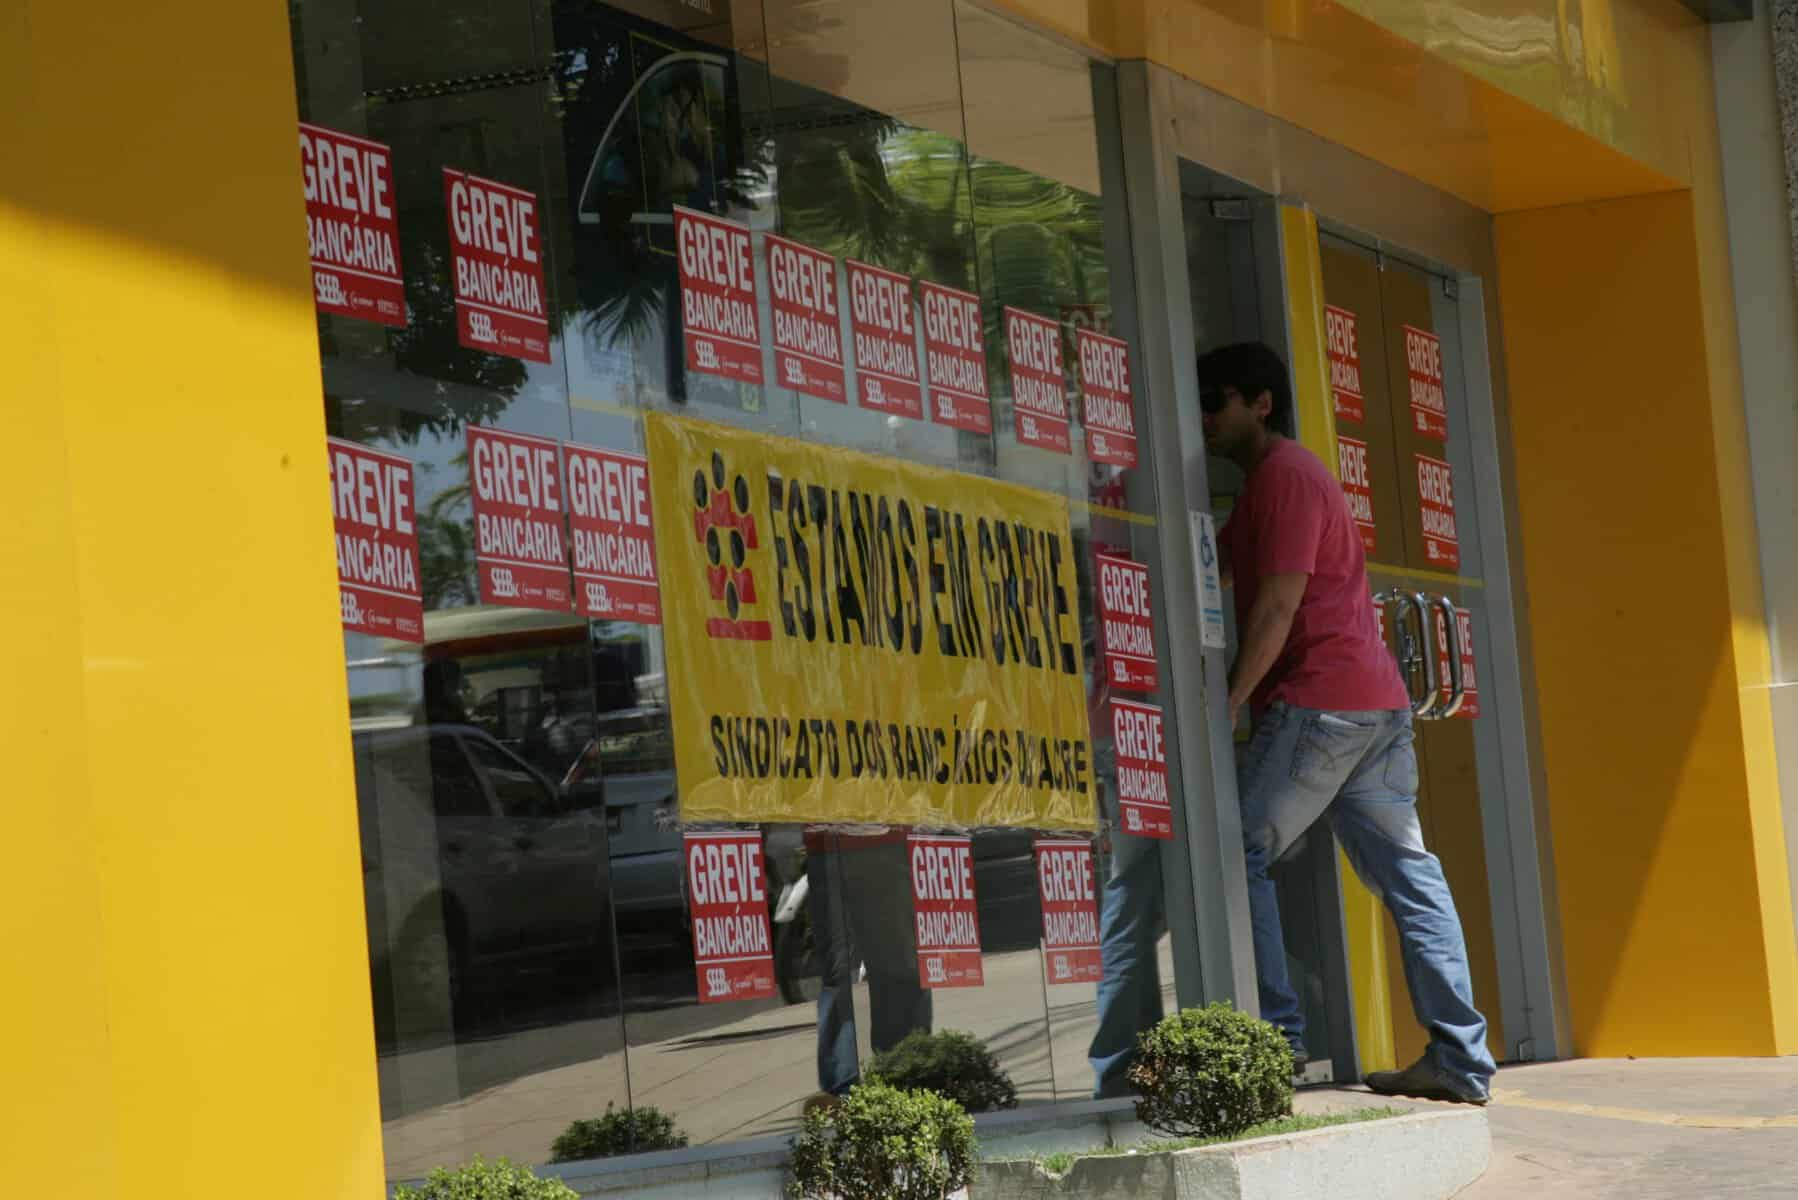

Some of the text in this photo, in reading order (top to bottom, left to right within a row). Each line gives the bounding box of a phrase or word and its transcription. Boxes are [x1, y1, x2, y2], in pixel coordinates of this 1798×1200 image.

[300, 133, 391, 219] GREVE
[451, 182, 537, 262] GREVE
[679, 218, 752, 292] GREVE
[770, 245, 836, 315] GREVE
[456, 256, 542, 315] BANCÁRIA
[851, 270, 912, 335] GREVE
[684, 288, 757, 341] BANCÁRIA
[776, 309, 840, 361] BANCÁRIA
[924, 290, 981, 352] GREVE
[1326, 312, 1357, 358] REVE
[856, 332, 916, 379] BANCÁRIA
[929, 350, 985, 395] BANCÁRIA
[1009, 316, 1062, 376] GREVE
[1080, 337, 1130, 394] GREVE
[1407, 332, 1441, 379] GREVE
[1013, 373, 1065, 417] BANCÁRIA
[1084, 392, 1134, 433] BANCÁRIA
[473, 438, 558, 511] GREVE
[568, 455, 649, 527] GREVE
[1338, 443, 1369, 488] REVE
[1418, 460, 1453, 507] GREVE
[329, 453, 413, 535] REVE
[336, 531, 417, 591] ANCÁRIA
[479, 508, 564, 562] BANCÁRIA
[574, 525, 654, 577] BANCÁRIA
[767, 474, 1077, 675] ESTAMOS EM GREVE
[1101, 564, 1150, 618] GREVE
[1105, 616, 1154, 656] BANCÁRIA
[1438, 612, 1472, 655] GVE
[711, 715, 840, 779] SINDICATO
[847, 719, 888, 779] DOS
[1039, 737, 1087, 794] ACRE
[1114, 708, 1164, 763] GREVE
[1119, 763, 1168, 802] BANCÁRIA
[690, 844, 764, 904] GREVE
[912, 847, 974, 901] GREVE
[1040, 850, 1094, 902] GREVE
[696, 905, 769, 956] BANCÁRIA
[917, 903, 977, 946] BANCÁRIA
[1045, 903, 1098, 945] BANCÁRIA
